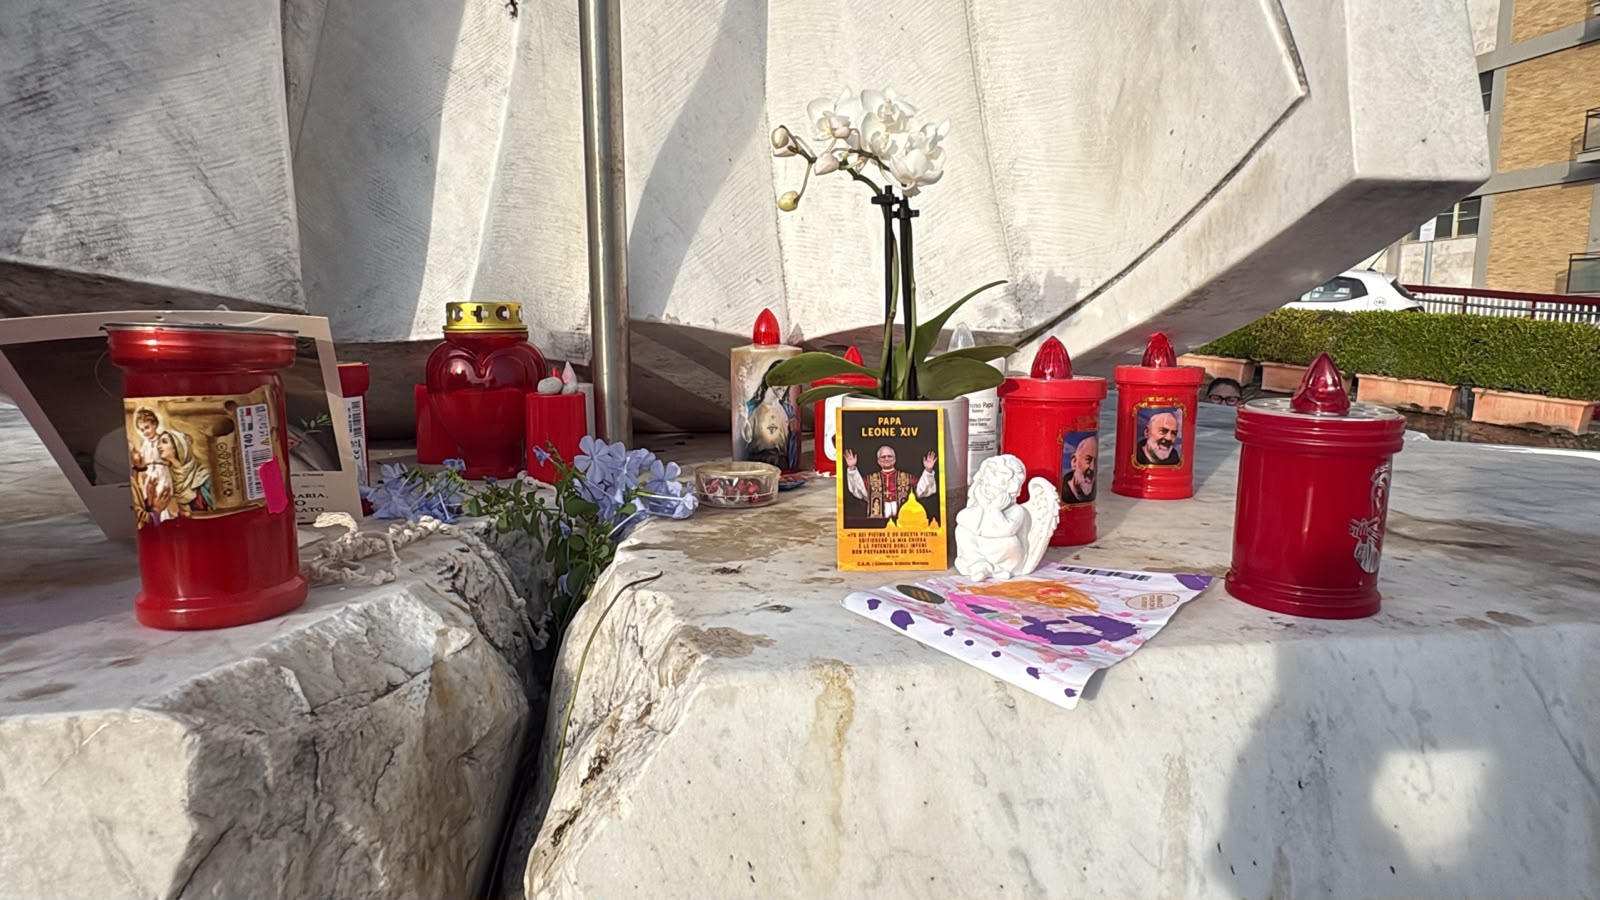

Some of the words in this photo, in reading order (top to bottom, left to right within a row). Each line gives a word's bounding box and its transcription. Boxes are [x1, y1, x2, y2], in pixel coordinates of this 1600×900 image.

[878, 416, 902, 426] PAPA
[861, 427, 896, 437] LEONE
[900, 426, 918, 437] XIV
[243, 434, 254, 449] T40
